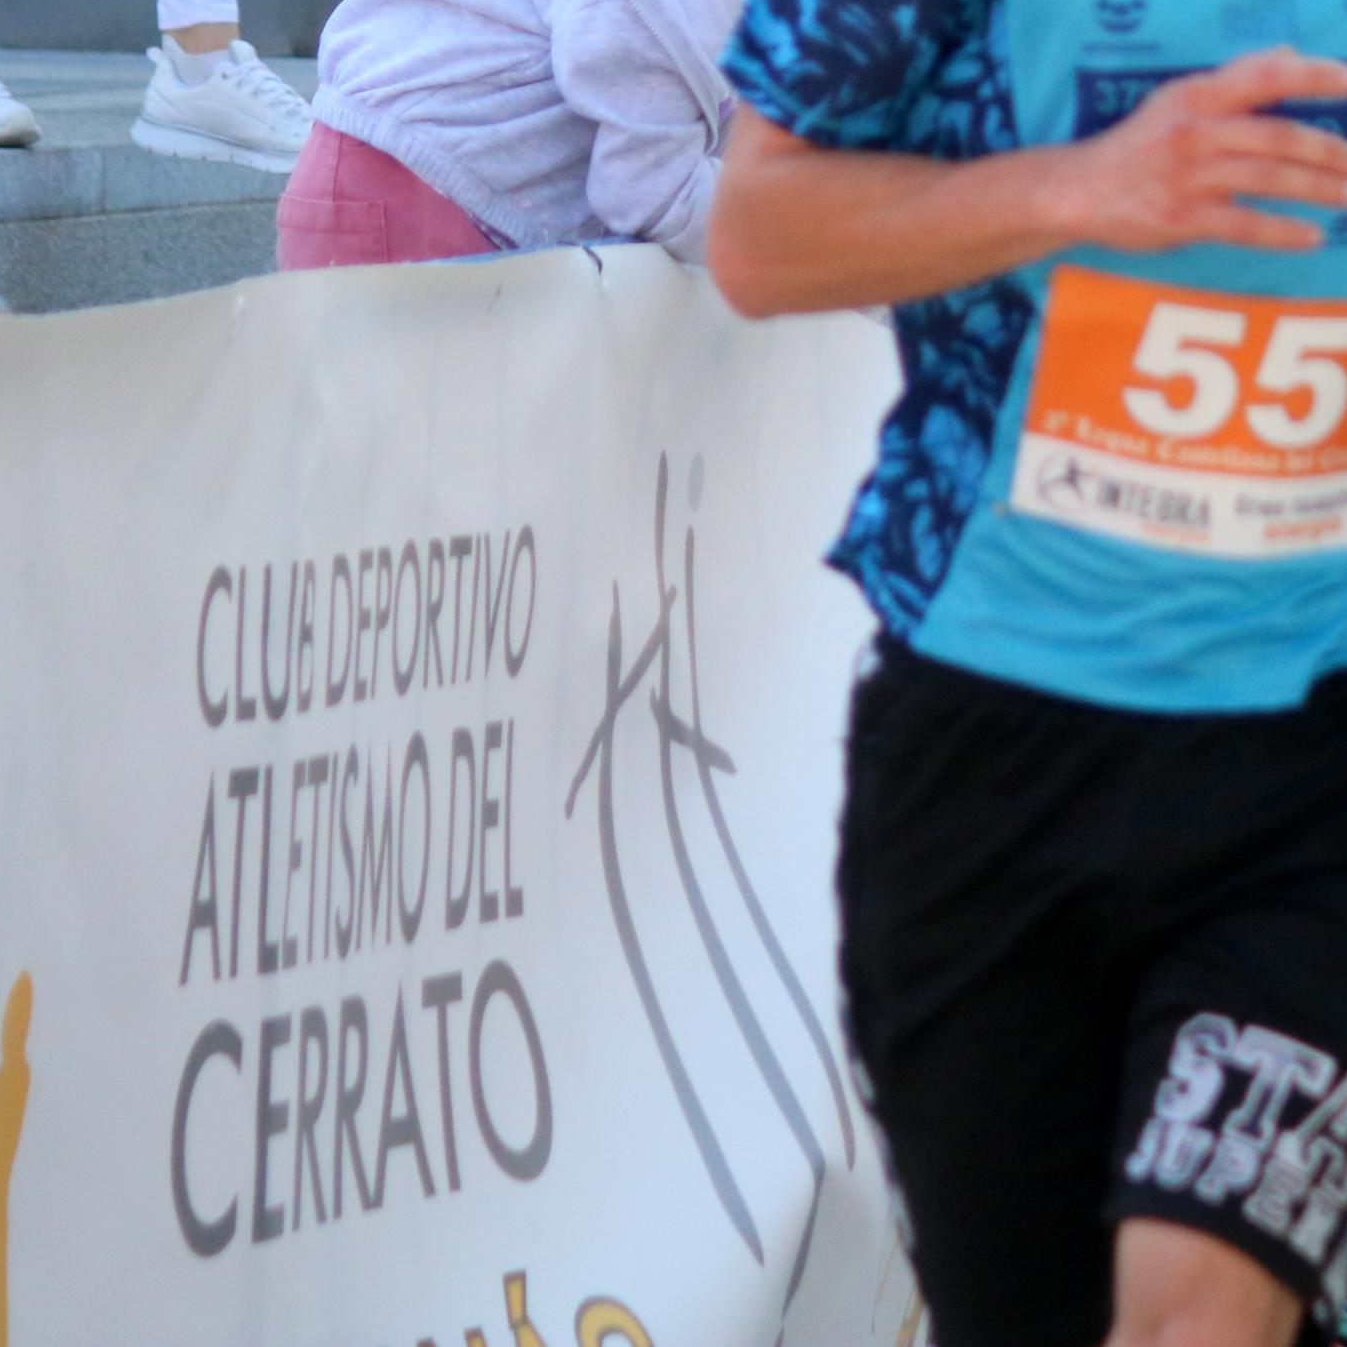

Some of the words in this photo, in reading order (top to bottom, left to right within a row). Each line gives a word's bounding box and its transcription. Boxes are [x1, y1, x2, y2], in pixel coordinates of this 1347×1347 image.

[196, 559, 316, 729] CLUB
[325, 523, 537, 708] DEPORTIVO
[178, 730, 432, 987] ATLETISMO
[445, 717, 524, 932] DEL
[170, 958, 553, 1260] CERRATO
